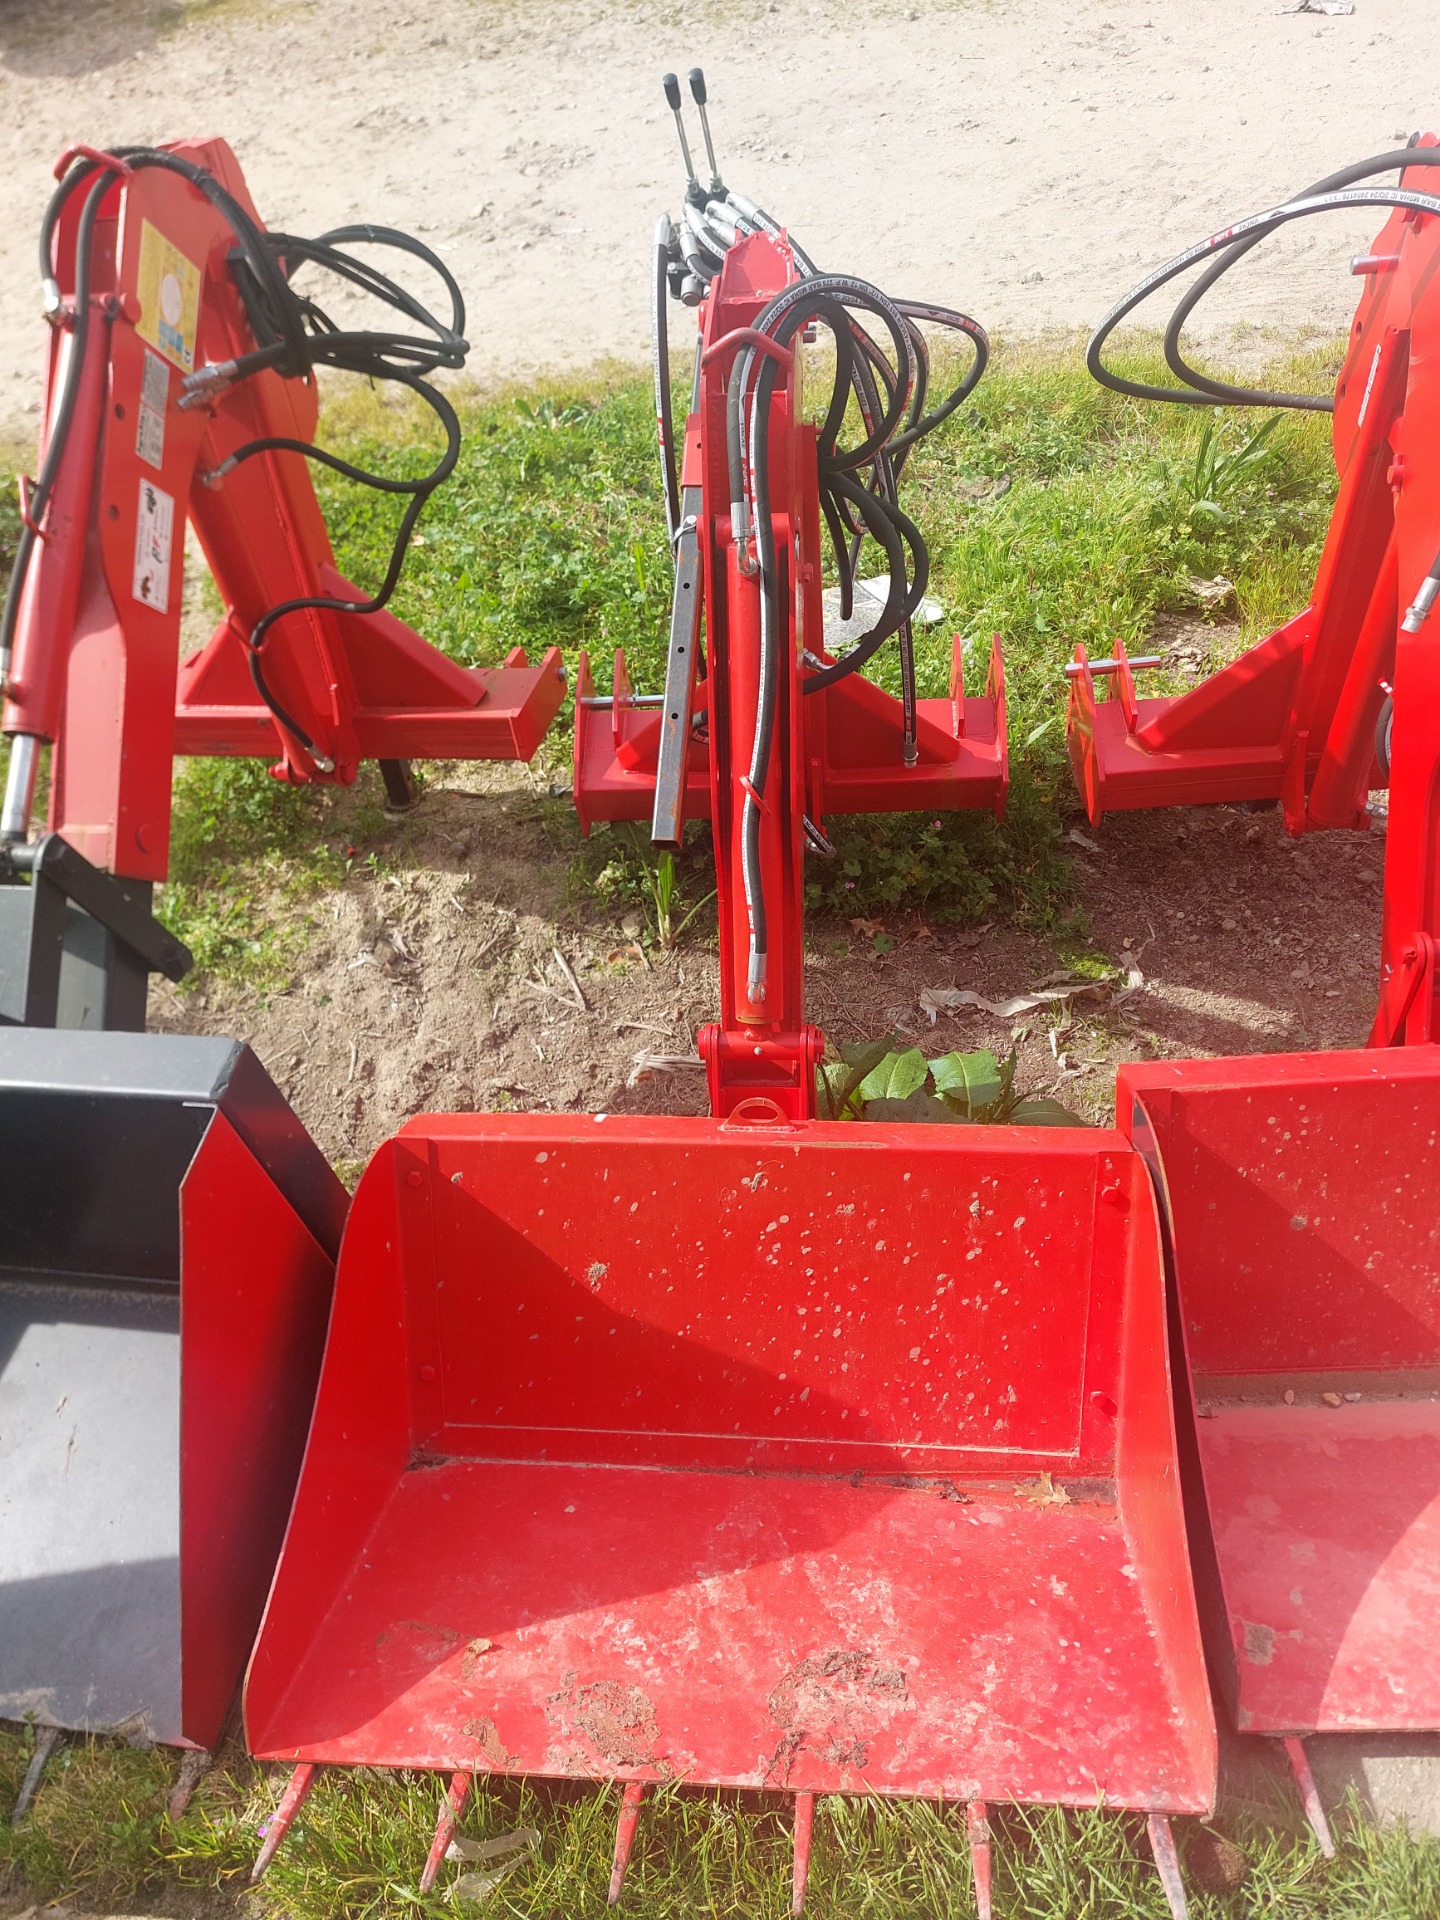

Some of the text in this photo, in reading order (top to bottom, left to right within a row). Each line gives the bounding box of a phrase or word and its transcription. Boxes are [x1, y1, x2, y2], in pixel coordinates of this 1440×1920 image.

[1400, 193, 1420, 203] MSHA
[808, 280, 821, 291] BAR
[822, 279, 833, 288] 275
[858, 282, 869, 292] DN
[789, 286, 807, 301] MSHA
[782, 297, 790, 307] IC
